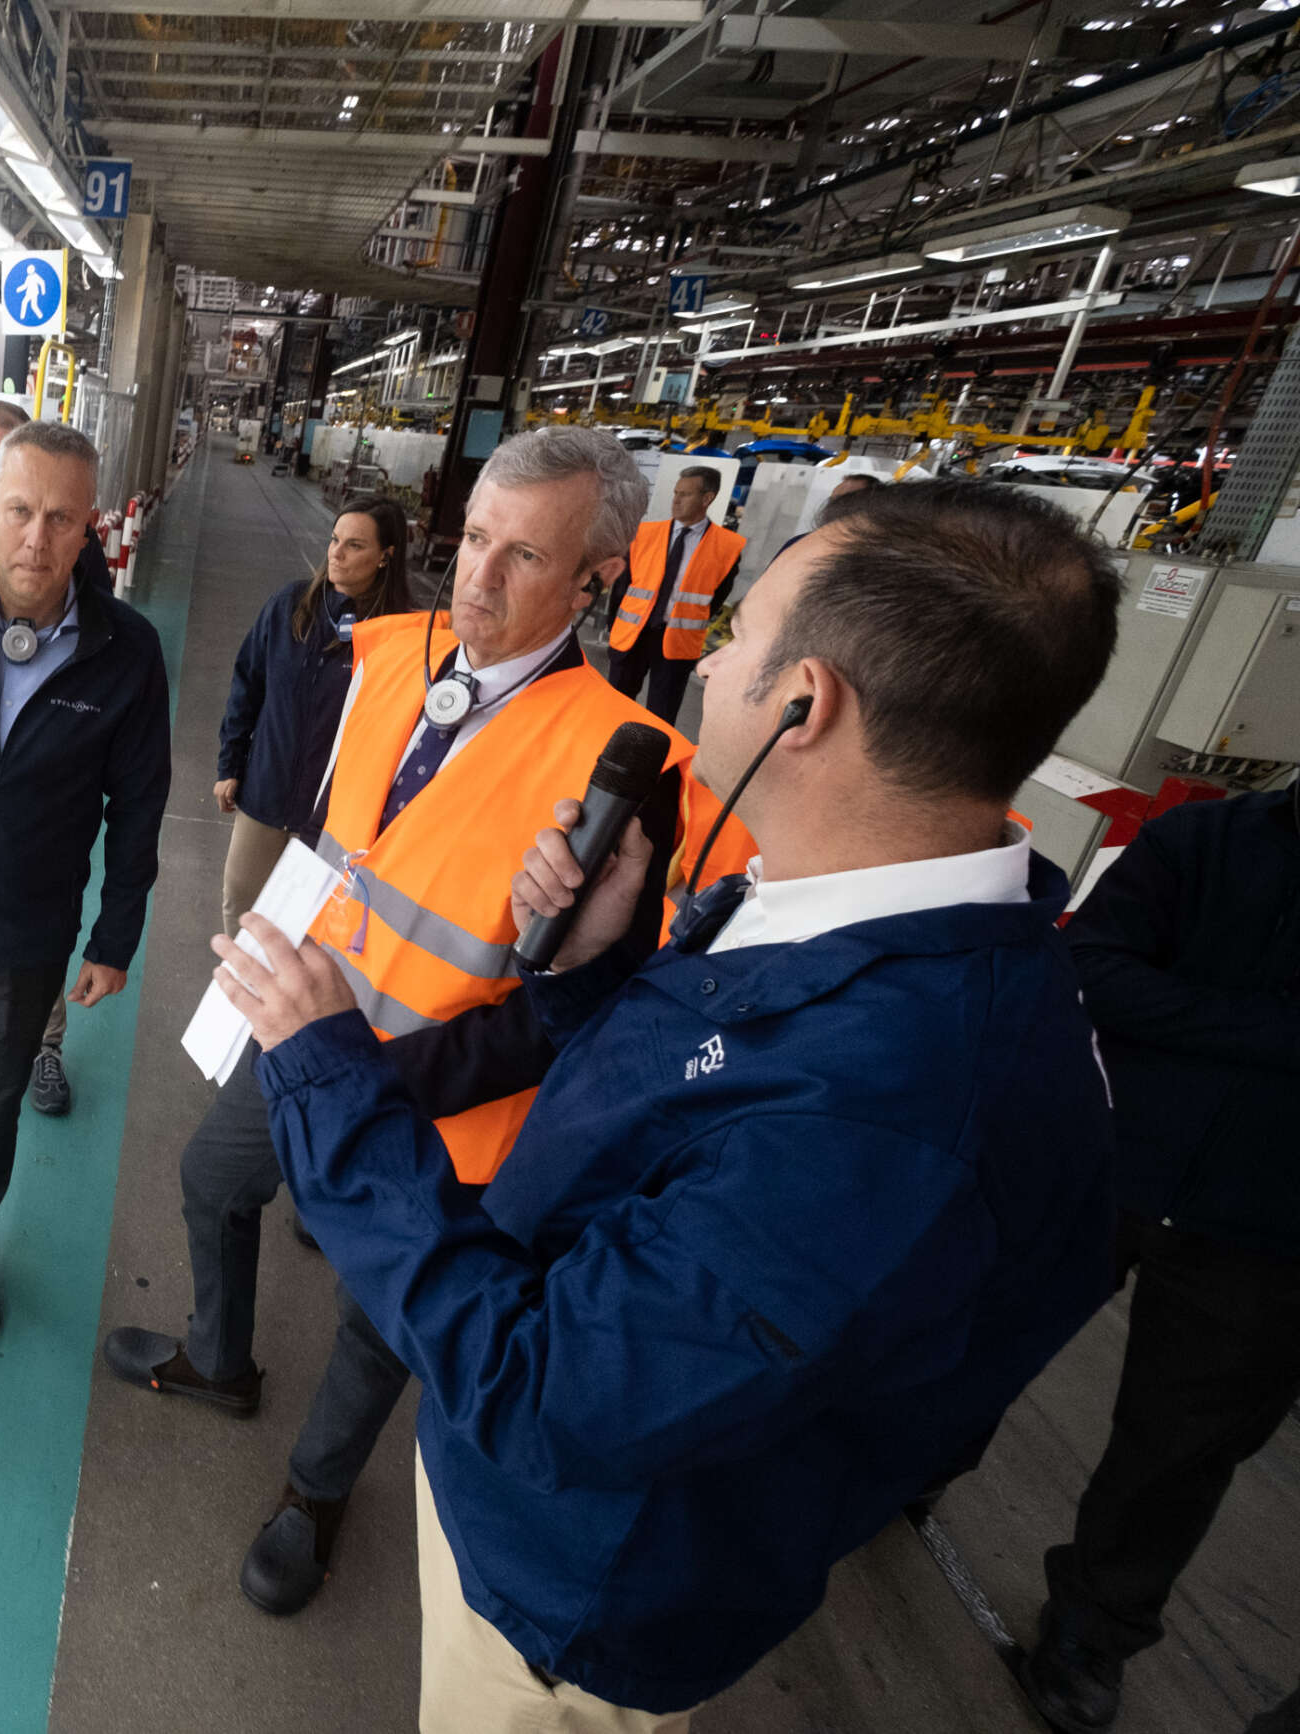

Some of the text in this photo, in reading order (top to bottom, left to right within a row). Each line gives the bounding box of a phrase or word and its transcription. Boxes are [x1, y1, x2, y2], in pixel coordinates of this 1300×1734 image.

[86, 170, 126, 213] 91
[671, 278, 704, 313] 41
[582, 311, 608, 335] 42
